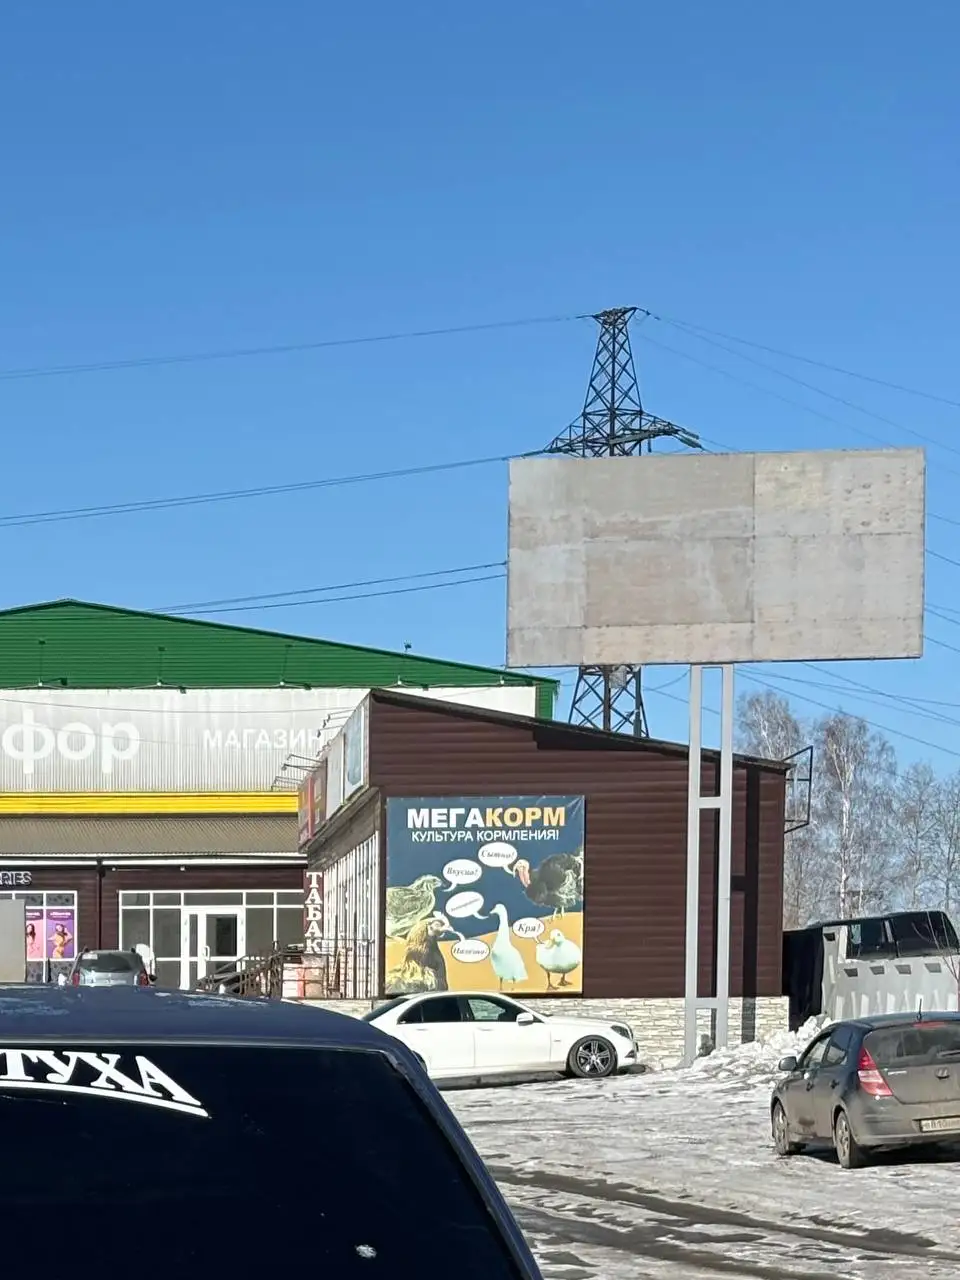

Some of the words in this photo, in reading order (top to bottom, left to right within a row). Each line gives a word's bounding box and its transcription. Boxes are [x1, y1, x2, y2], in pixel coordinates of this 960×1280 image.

[203, 728, 325, 749] МАГАЗИН
[407, 806, 566, 829] МЕГАКОРМ
[411, 831, 474, 842] КУЛЬТУРА
[477, 829, 560, 841] КОРМЛЕНИЯ!
[304, 871, 325, 954] ТАБАК
